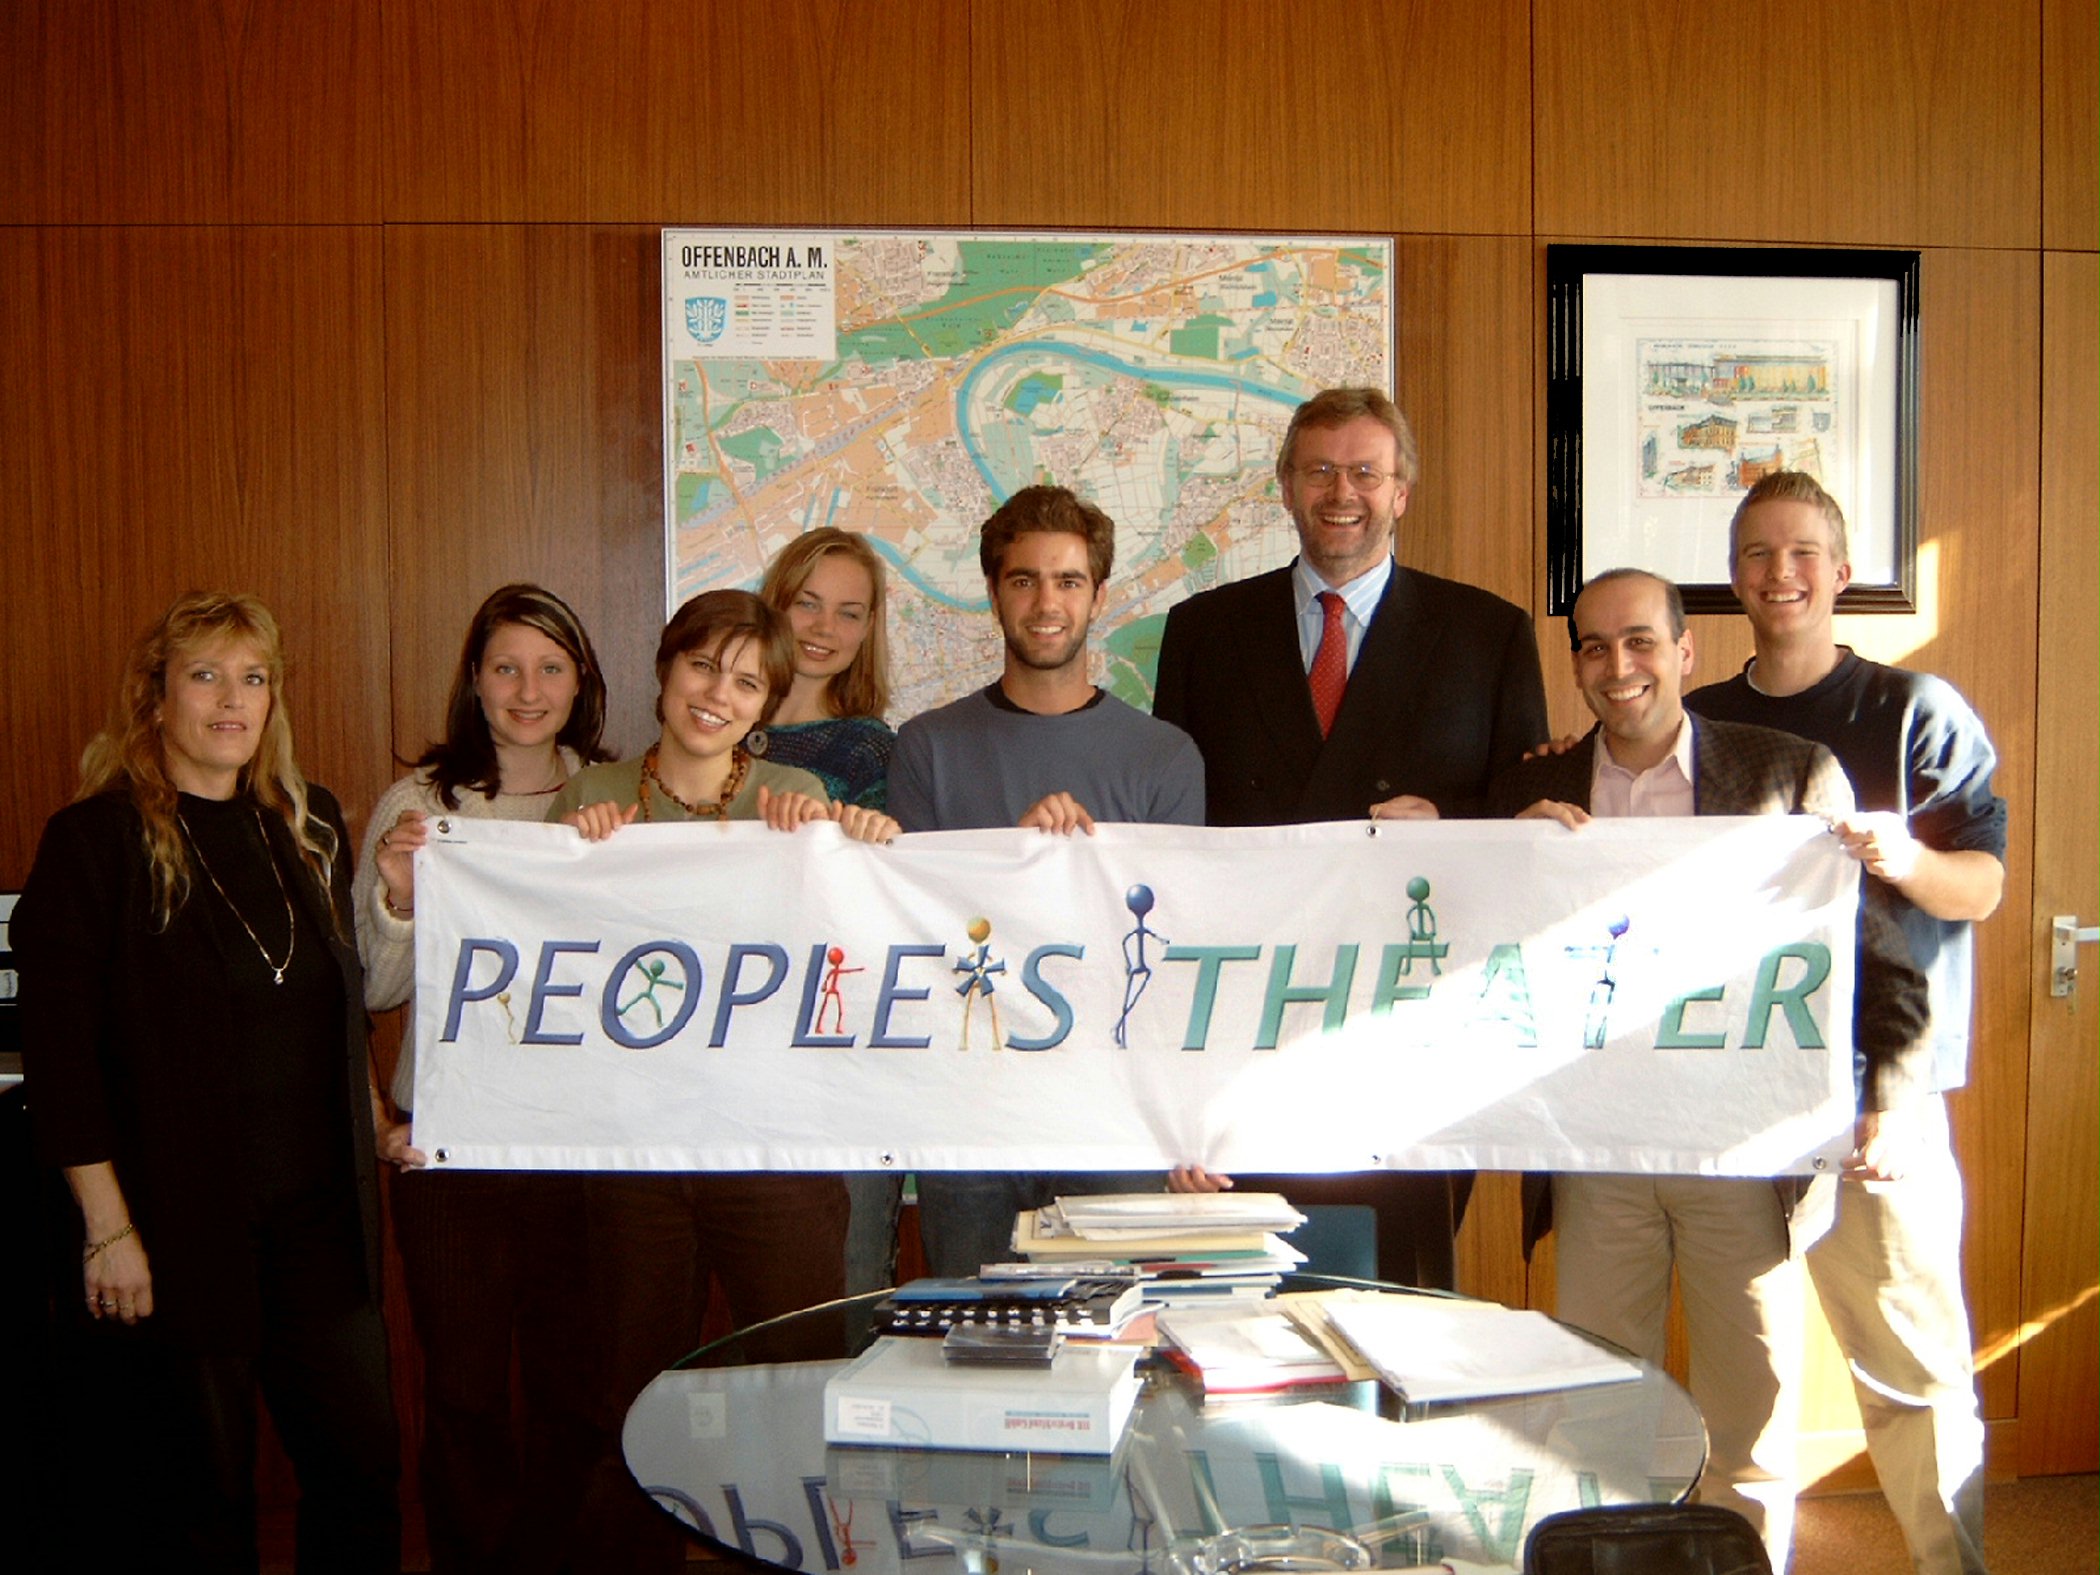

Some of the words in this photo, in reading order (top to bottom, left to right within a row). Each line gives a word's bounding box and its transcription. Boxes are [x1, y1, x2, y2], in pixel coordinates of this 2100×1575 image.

[681, 245, 780, 268] OFFENBACH
[786, 246, 802, 268] A.
[807, 246, 828, 269] M.
[684, 269, 753, 280] AMTLICHER
[756, 270, 825, 280] STADTPLAN
[1162, 941, 1832, 1051] THEATER
